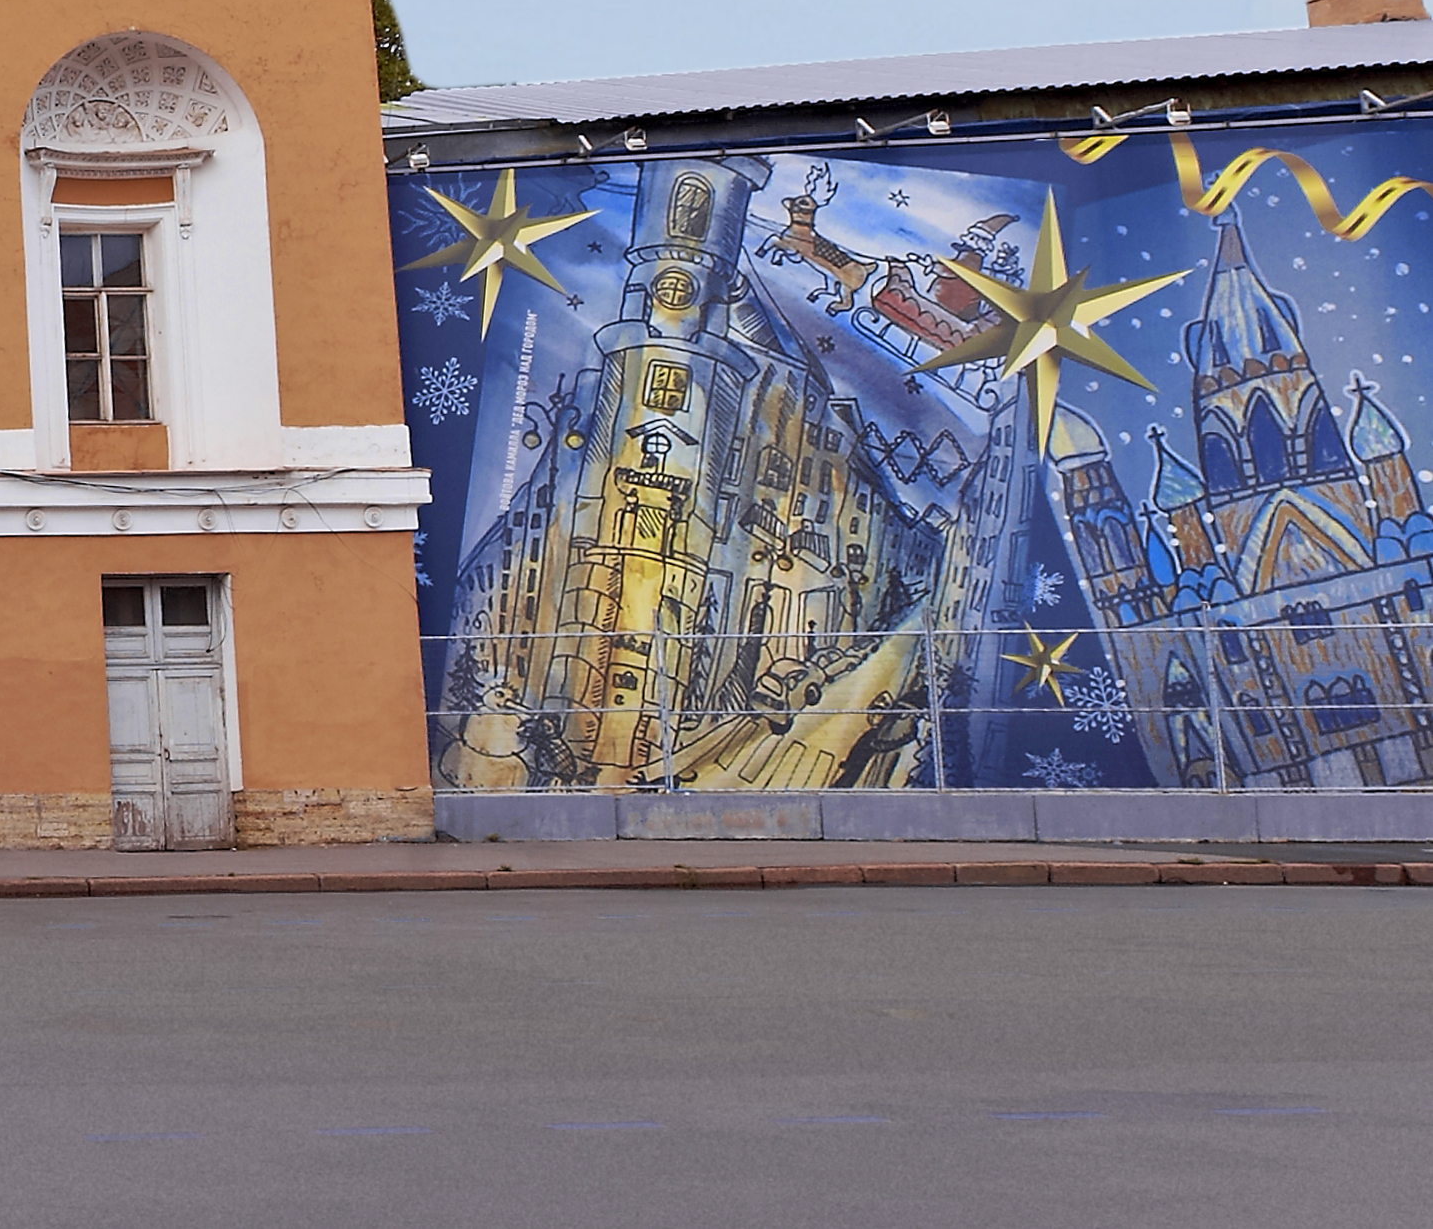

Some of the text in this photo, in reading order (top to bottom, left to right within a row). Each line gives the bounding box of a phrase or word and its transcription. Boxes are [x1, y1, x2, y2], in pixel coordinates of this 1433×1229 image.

[519, 355, 533, 373] НАД
[515, 374, 529, 405] МОРОЗ
[505, 429, 521, 471] КАМИЛЛА
